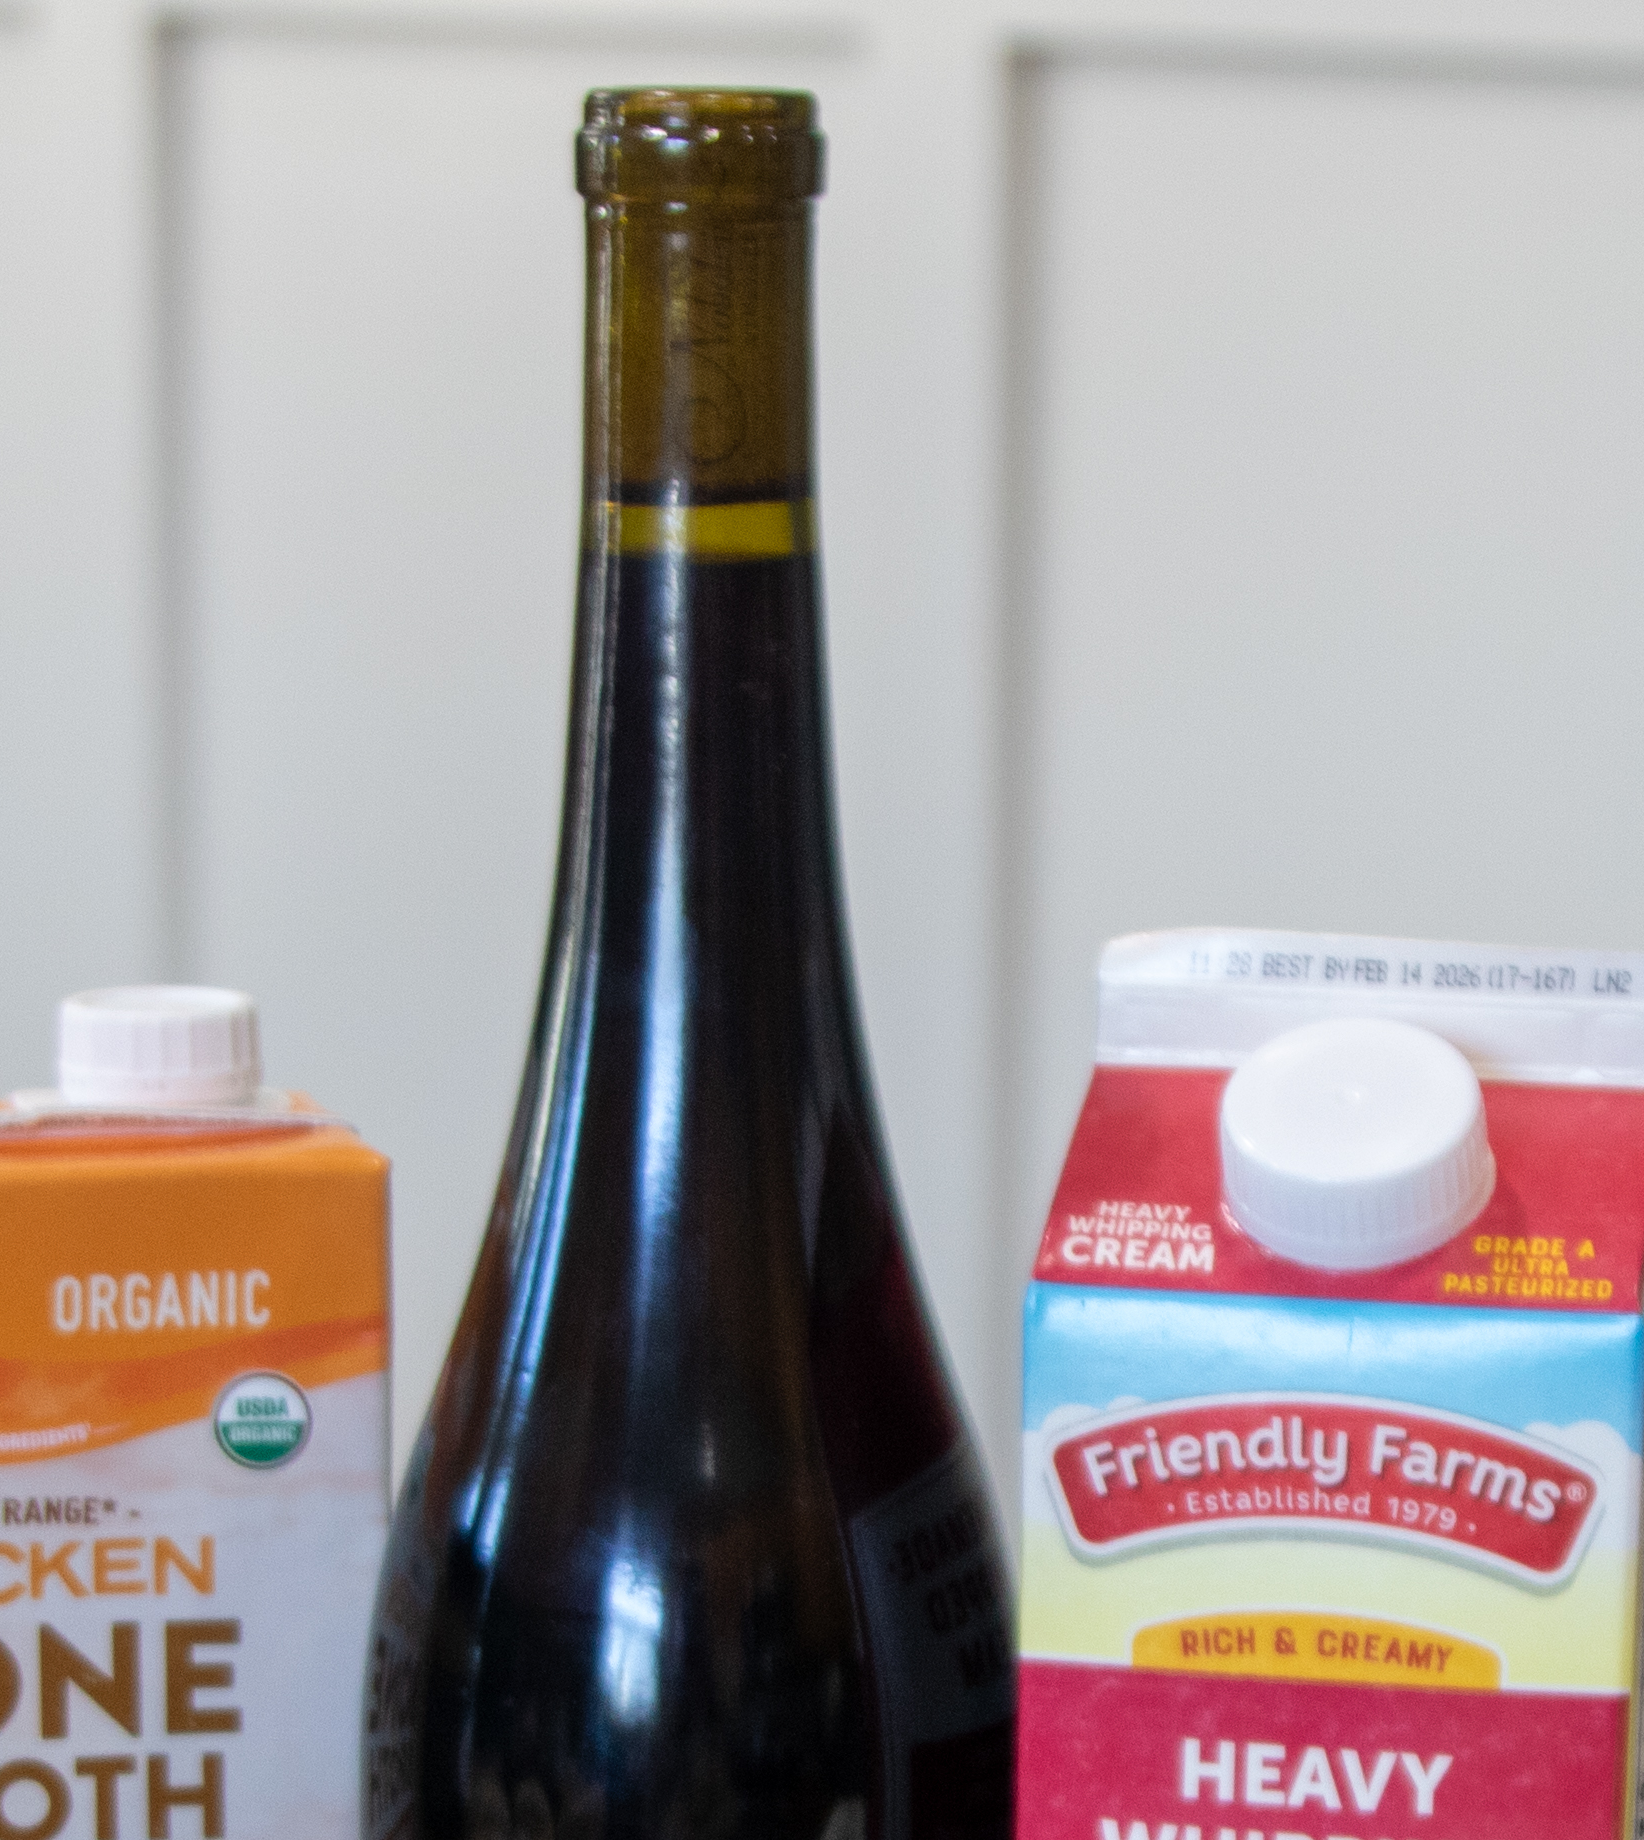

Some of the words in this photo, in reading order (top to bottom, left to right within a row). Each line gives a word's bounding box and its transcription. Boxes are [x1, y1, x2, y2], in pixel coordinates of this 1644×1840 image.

[1263, 953, 1313, 978] BEST
[1324, 956, 1353, 981] BY
[1354, 958, 1388, 984] FEB
[1400, 960, 1423, 985] 14
[1433, 962, 1482, 988] 2026
[1592, 970, 1635, 994] LN2
[1068, 1216, 1213, 1242] WHIPPING
[1100, 1201, 1192, 1223] HEAVY
[1062, 1235, 1215, 1273] CREAM
[1474, 1235, 1564, 1257] GRADE
[1578, 1239, 1595, 1259] A
[1493, 1253, 1569, 1276] ULTRA
[52, 1269, 272, 1335] ORGANIC
[1443, 1273, 1613, 1301] PASTEURIZED
[1081, 1416, 1350, 1496] Friendly
[1185, 1485, 1372, 1516] Established
[1387, 1497, 1458, 1533] 1979
[1180, 1627, 1256, 1658] RICH
[1275, 1627, 1298, 1656] &
[1317, 1629, 1454, 1674] CREAMY
[1179, 1736, 1453, 1817] HEAVY
